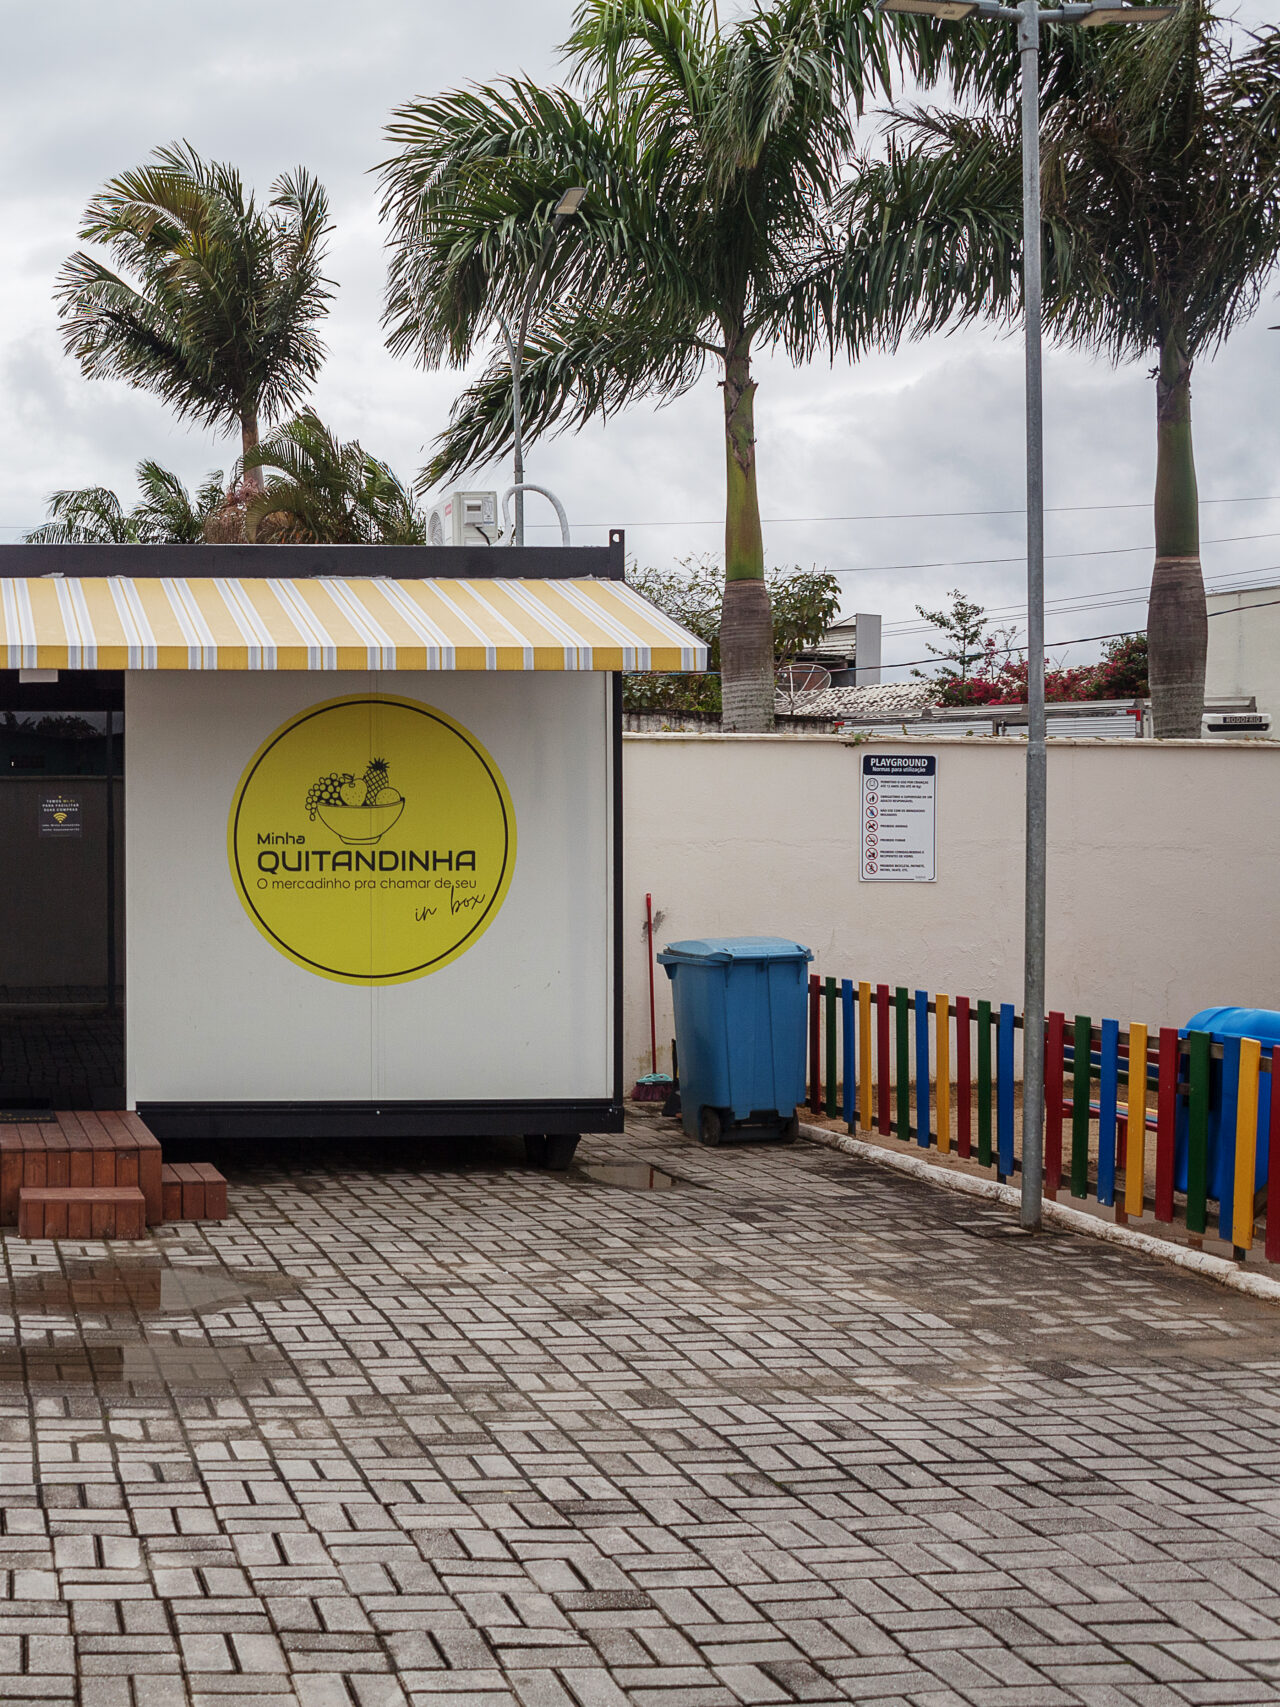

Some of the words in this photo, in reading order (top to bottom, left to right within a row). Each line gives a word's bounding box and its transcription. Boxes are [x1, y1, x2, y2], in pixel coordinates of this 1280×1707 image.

[870, 758, 928, 767] PLAYGROUND
[257, 832, 306, 845] Minha
[257, 850, 476, 875] QUITANDINHA
[256, 878, 269, 890] O
[272, 877, 351, 890] mercadinho
[354, 880, 377, 893] pra
[380, 877, 431, 890] chamar
[434, 877, 452, 890] de
[455, 880, 477, 890] seu
[415, 905, 438, 922] in
[450, 886, 486, 916] box
